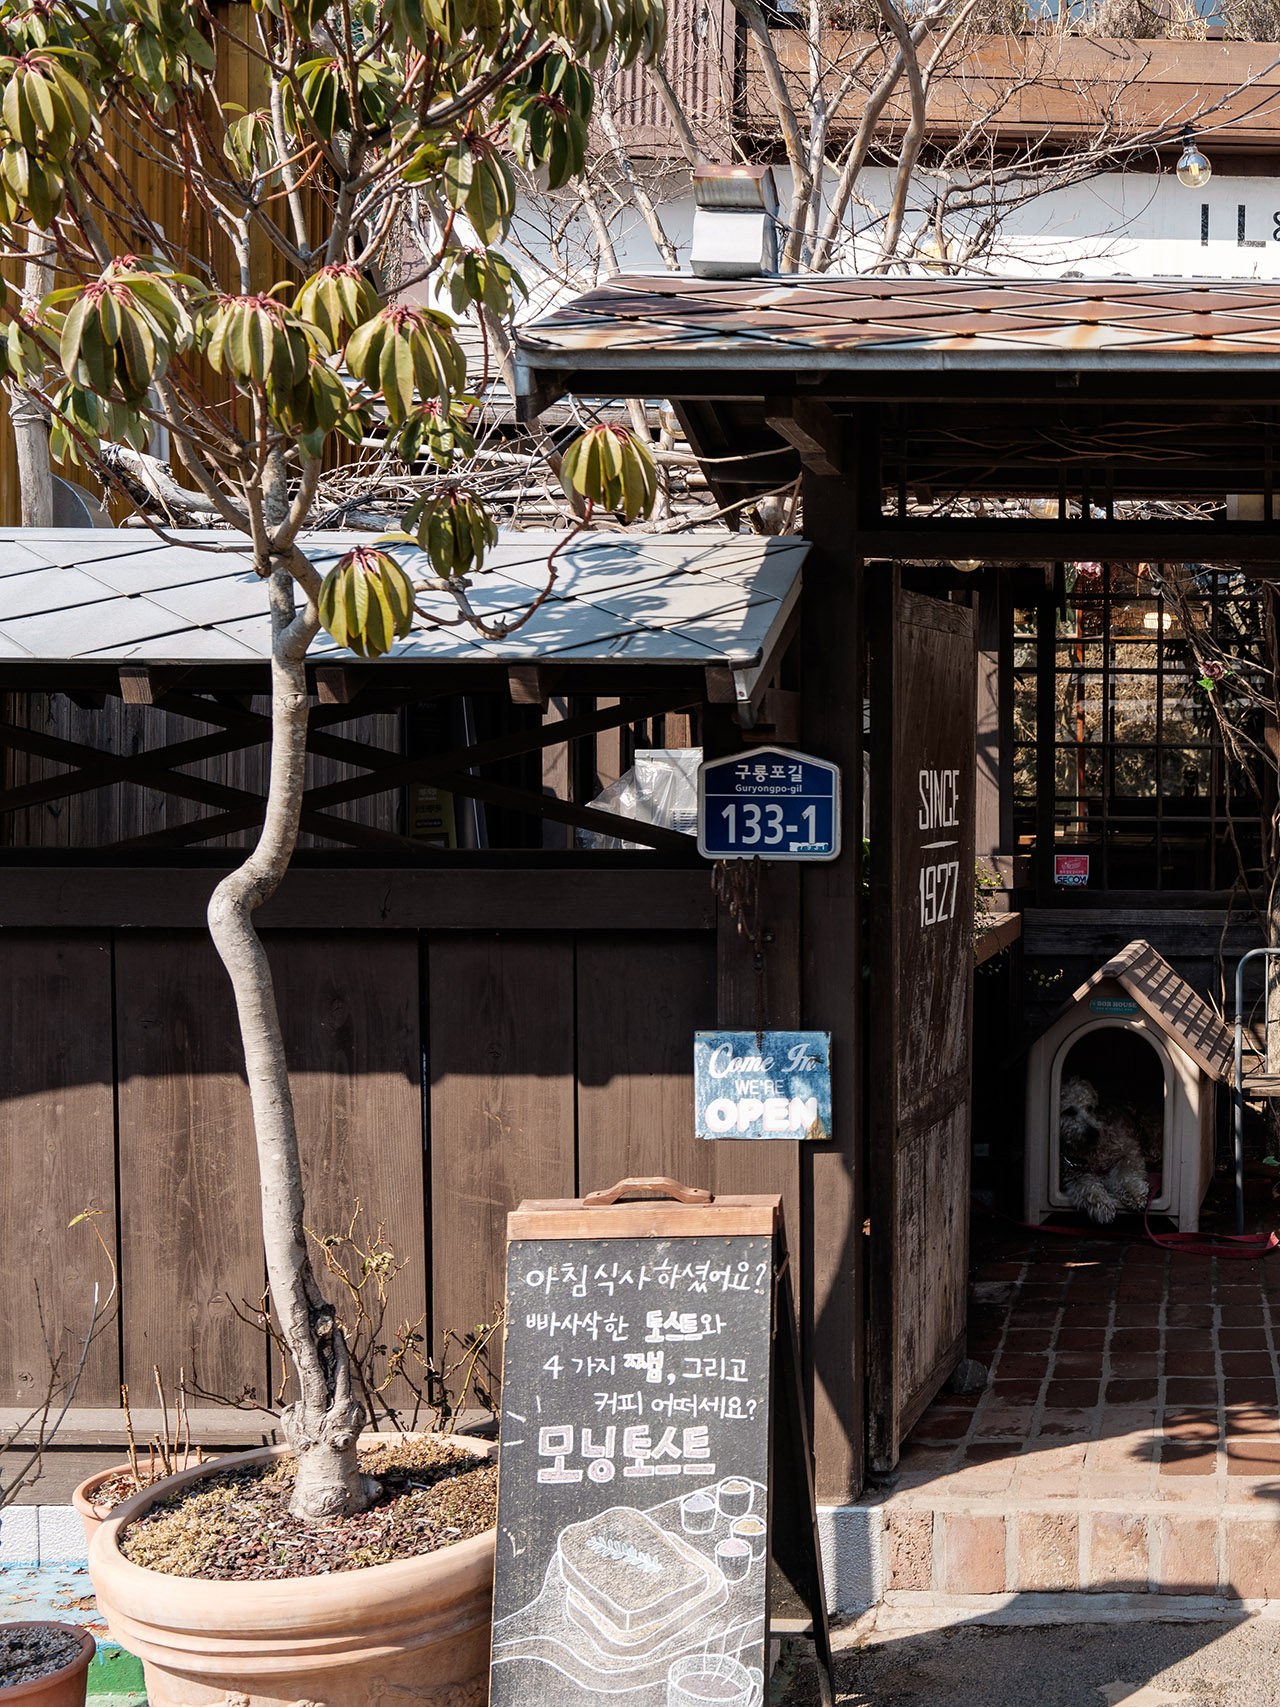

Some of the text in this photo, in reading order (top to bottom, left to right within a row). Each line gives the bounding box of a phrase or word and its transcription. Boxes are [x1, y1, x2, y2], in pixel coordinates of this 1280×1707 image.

[1200, 203, 1210, 247] I
[734, 764, 803, 783] 구룡포길
[734, 783, 803, 795] Guryongpo-gil
[918, 769, 960, 831] SINCE
[720, 803, 820, 846] 133-1
[919, 860, 960, 928] 1927
[1057, 875, 1087, 885] SECOM
[708, 1041, 819, 1080] Come In
[734, 1079, 785, 1096] WE'RE
[704, 1096, 820, 1134] OPEN
[653, 1257, 768, 1295] 하셨어요?
[525, 1309, 728, 1343] 빠사삭한 토스트와
[542, 1354, 564, 1381] 4
[571, 1355, 616, 1378] 가지
[682, 1356, 749, 1383] 그리고
[593, 1390, 758, 1421] 커피 어떠세요?
